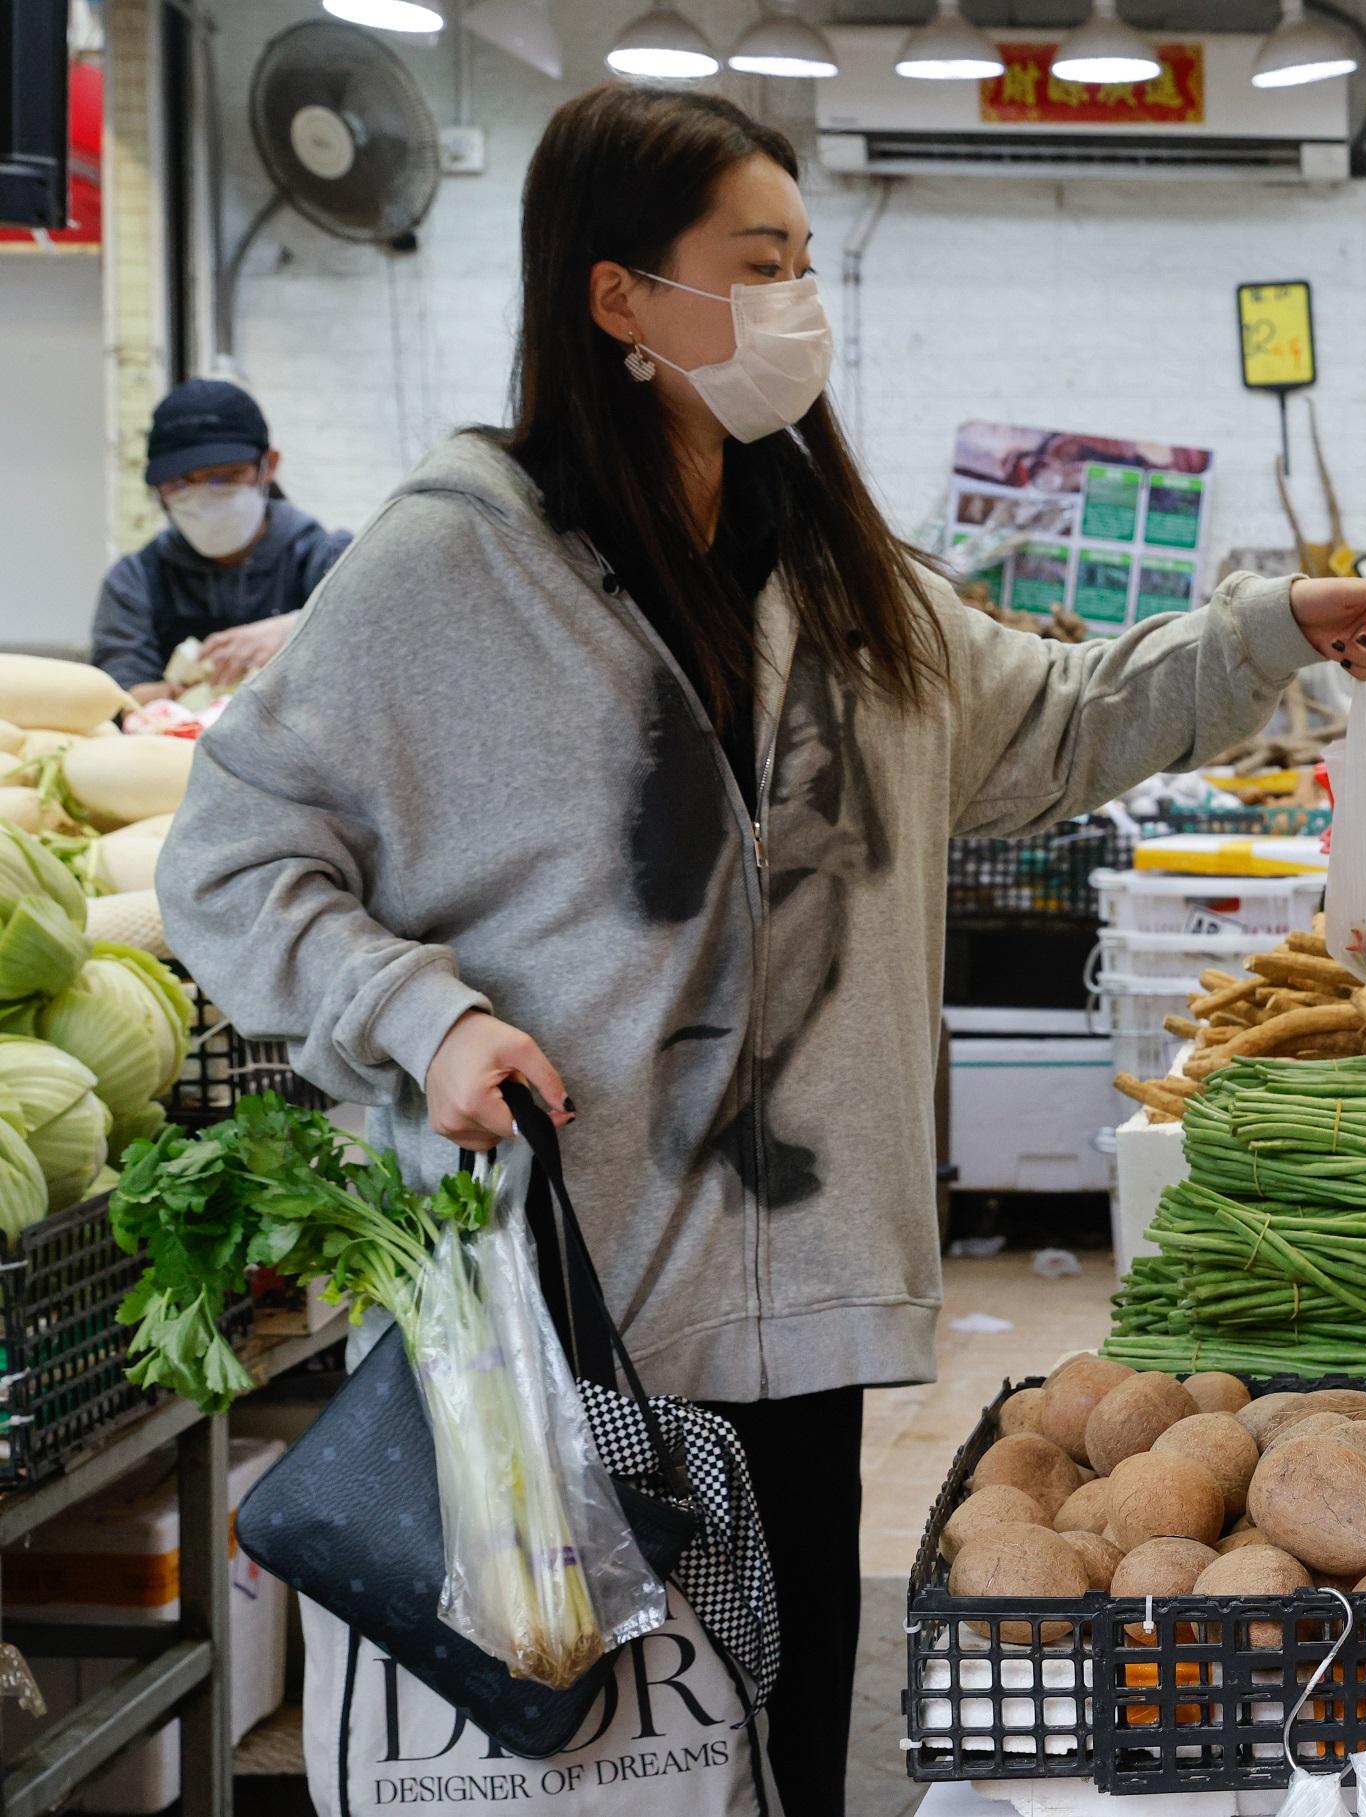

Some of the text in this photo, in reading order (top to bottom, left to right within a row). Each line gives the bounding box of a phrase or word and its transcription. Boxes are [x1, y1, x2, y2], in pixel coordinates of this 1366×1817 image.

[375, 1741, 730, 1804] DESIGNER OF DREAMS
